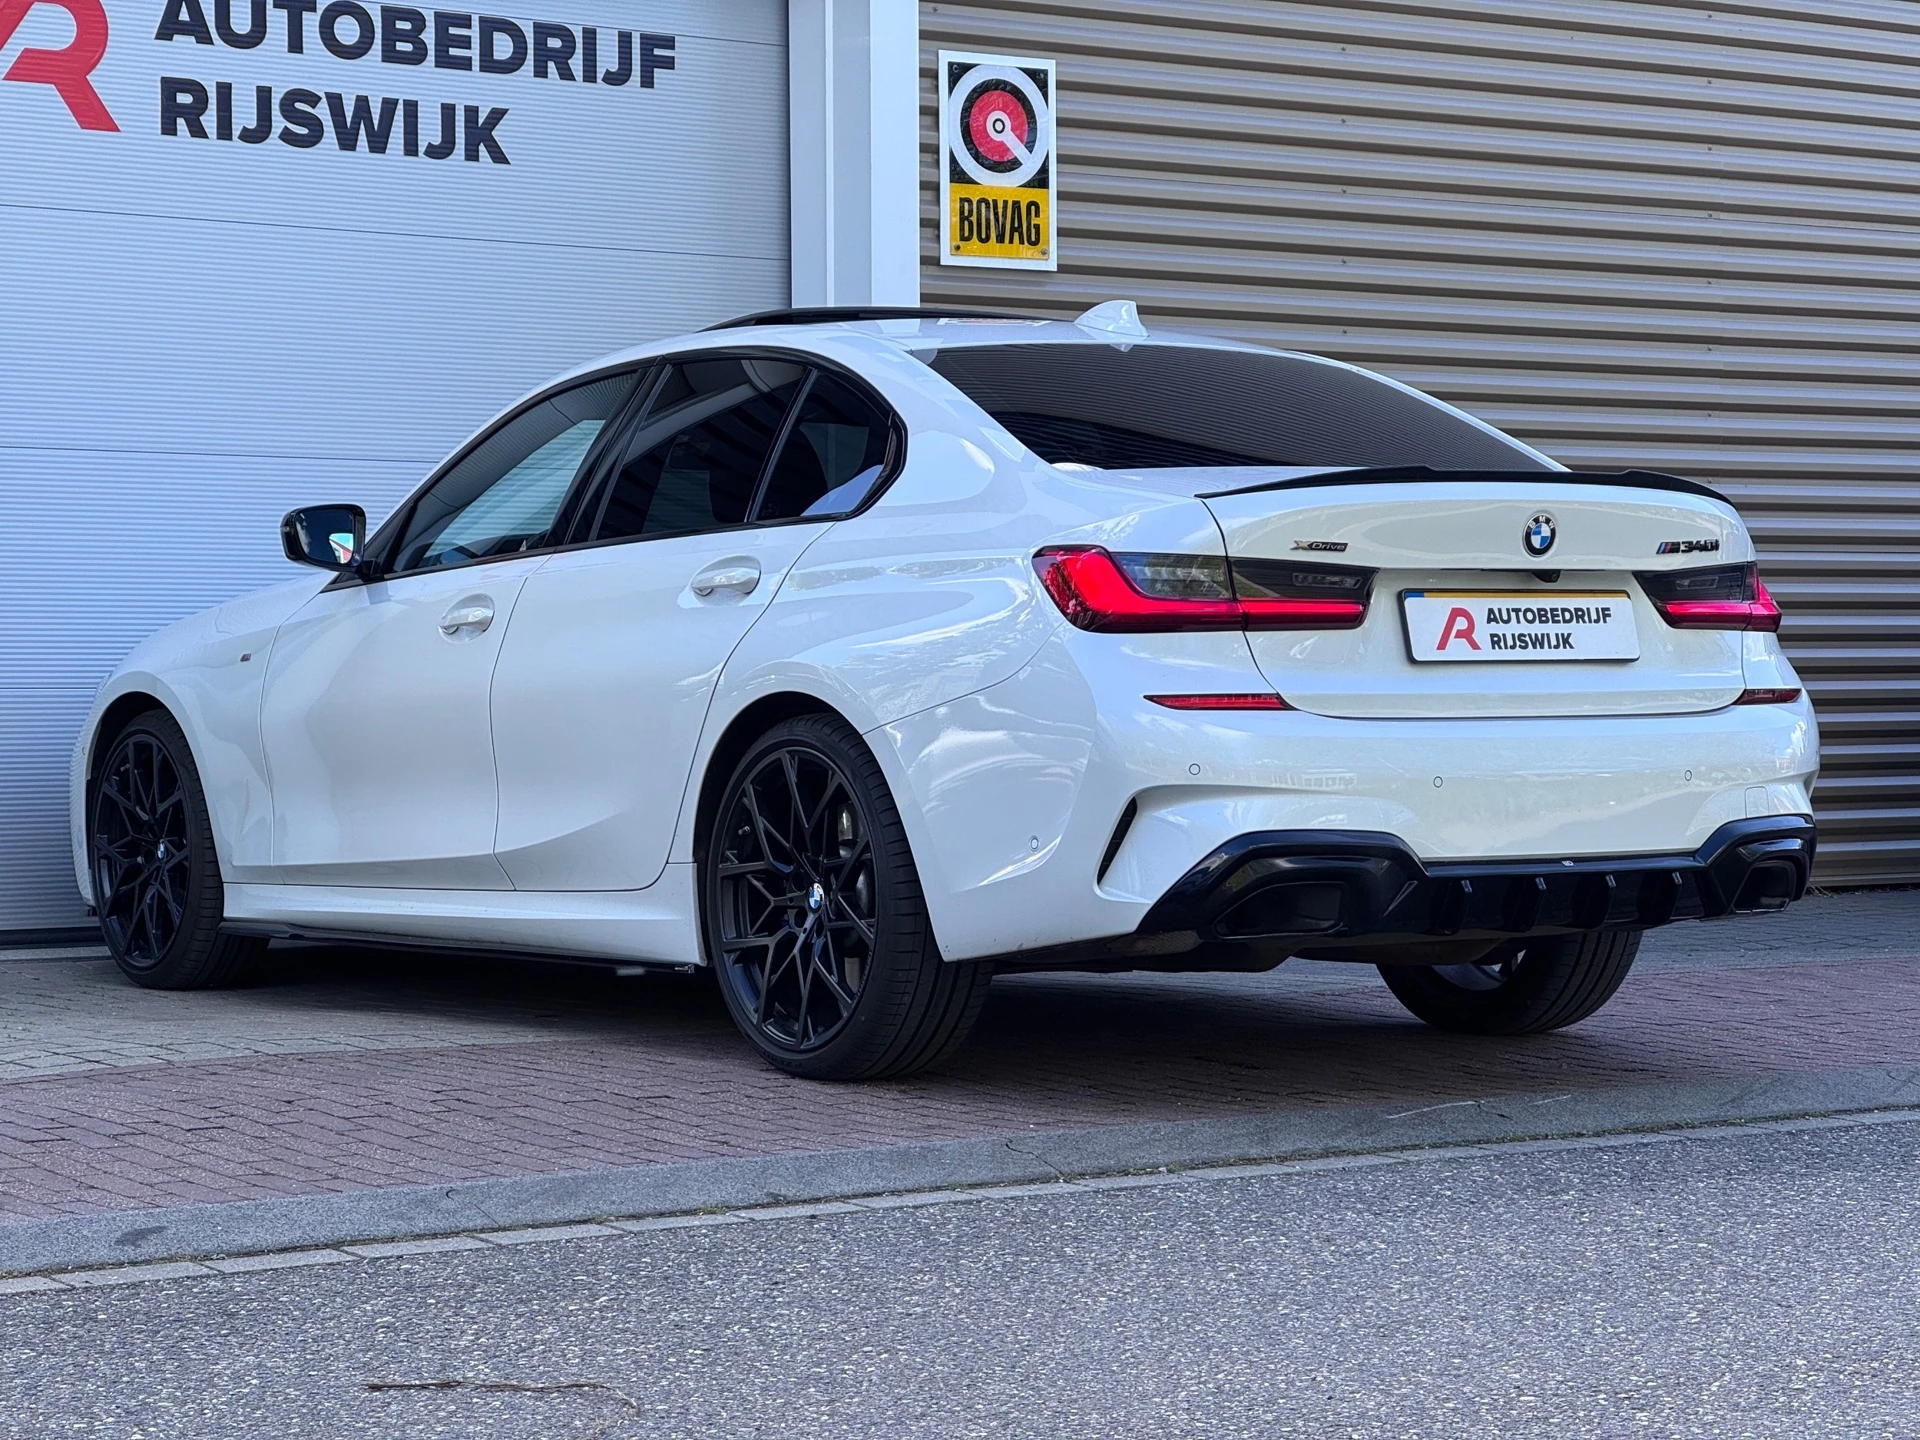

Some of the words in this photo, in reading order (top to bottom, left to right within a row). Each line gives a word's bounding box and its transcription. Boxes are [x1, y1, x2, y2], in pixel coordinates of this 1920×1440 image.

[154, 0, 676, 89] AUTOBEDRIJF
[160, 76, 511, 165] RIJSWIJK
[958, 196, 1041, 247] BOVAG
[1486, 607, 1612, 625] AUTOBEDRIJF
[1489, 632, 1575, 651] RIJSWIJK
